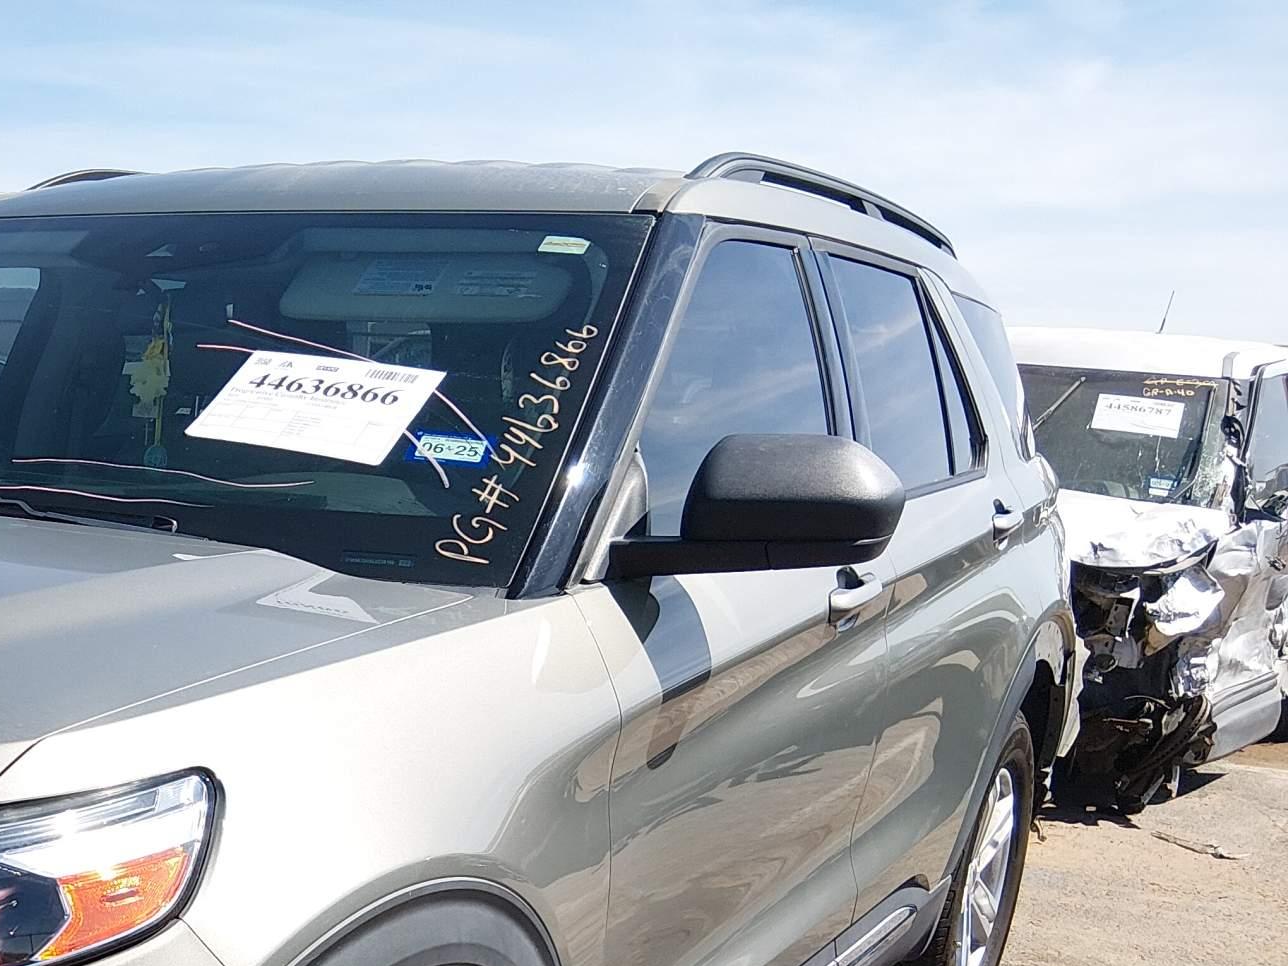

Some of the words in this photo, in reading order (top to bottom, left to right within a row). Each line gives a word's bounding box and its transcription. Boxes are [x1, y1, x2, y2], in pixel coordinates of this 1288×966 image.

[249, 373, 404, 406] 44636866
[491, 324, 599, 468] 44636866
[454, 445, 480, 457] 25
